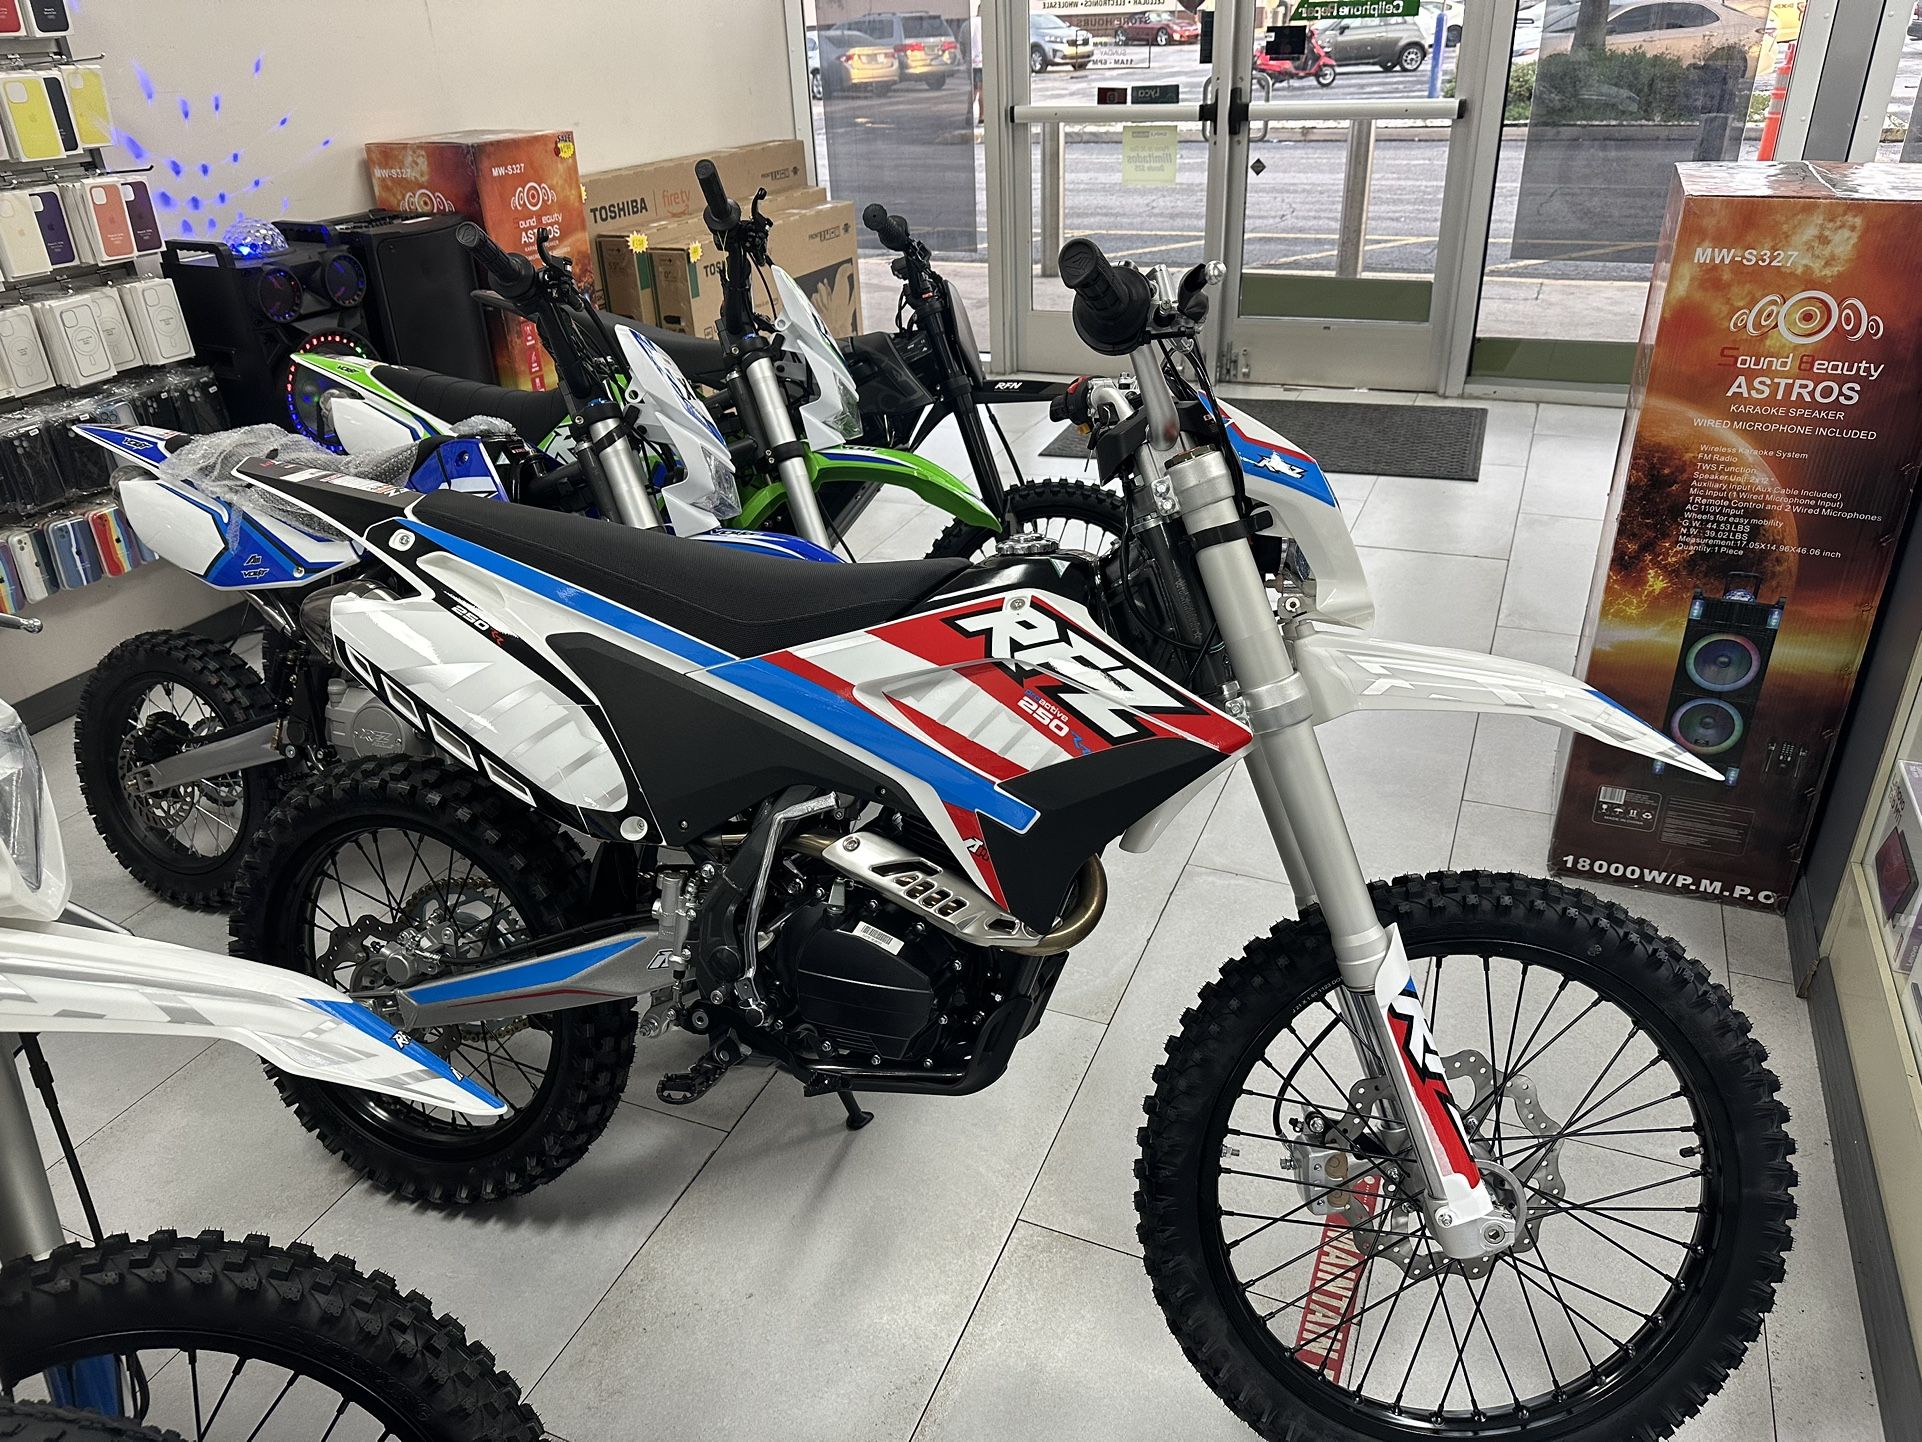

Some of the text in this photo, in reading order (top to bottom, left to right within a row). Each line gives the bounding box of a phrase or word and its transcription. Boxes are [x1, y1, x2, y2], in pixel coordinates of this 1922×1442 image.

[374, 168, 412, 178] MW-S327
[492, 163, 525, 177] MW-S327
[590, 197, 649, 224] TOSHIBA
[513, 212, 563, 228] ound eauty
[521, 225, 561, 244] ASTOS
[1693, 247, 1799, 267] MW-S327
[1717, 346, 1885, 381] Sound Beauty
[994, 381, 1023, 390] RFN
[1726, 375, 1861, 405] ASTROS
[1730, 403, 1845, 421] KARAOKE SPEAKER
[1693, 417, 1877, 440] WIRED MICROPHONE INCLUDED
[1700, 444, 1808, 459] Wireless Karaoke System
[1713, 454, 1738, 463] Radio
[1693, 471, 1728, 481] Speaker
[1697, 463, 1757, 474] TWS Function
[1691, 480, 1842, 501] Auxiliary Input (Aux Cable Included)
[1706, 489, 1727, 498] Input
[1739, 491, 1765, 501] Wired
[1766, 494, 1816, 506] Microphone
[1817, 500, 1843, 509] Input)
[1701, 505, 1721, 513] 110V
[1722, 507, 1744, 516] Input
[1731, 499, 1764, 509] Control
[1765, 503, 1783, 511] and
[1792, 505, 1820, 515] Wired
[1821, 508, 1882, 522] Microphones
[1683, 512, 1714, 520] Wheels
[1729, 516, 1749, 525] easy
[1750, 518, 1784, 529] mobility
[1706, 522, 1731, 531] 44.53
[1731, 524, 1751, 533] LBS
[1704, 530, 1728, 539] 39.02
[1729, 532, 1749, 541] LBS
[1720, 546, 1744, 556] Piece
[1822, 549, 1842, 558] inch
[450, 604, 490, 631] 250
[1017, 695, 1070, 737] 250
